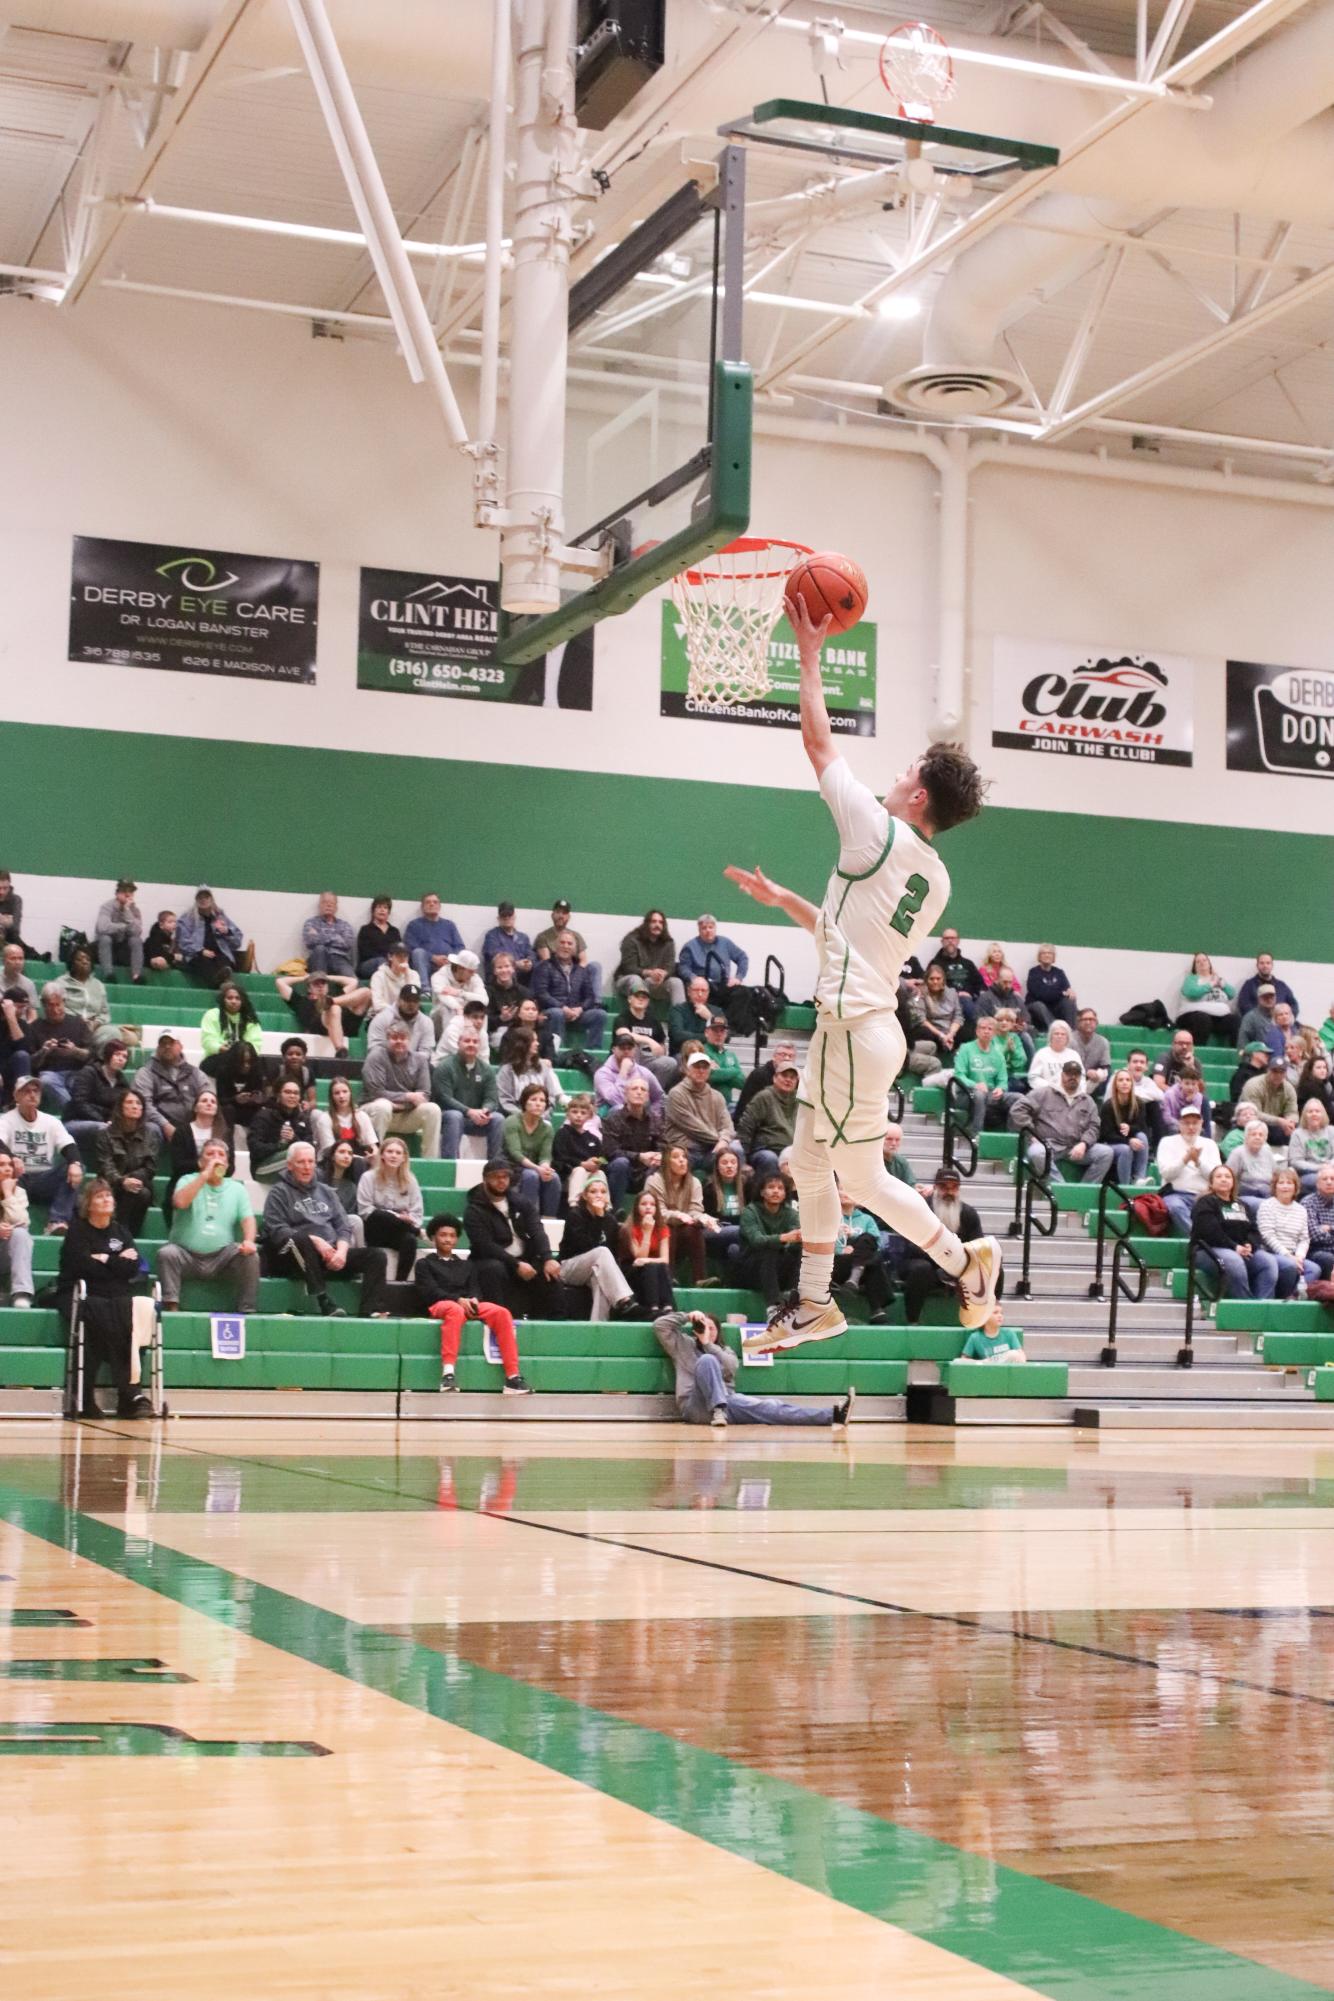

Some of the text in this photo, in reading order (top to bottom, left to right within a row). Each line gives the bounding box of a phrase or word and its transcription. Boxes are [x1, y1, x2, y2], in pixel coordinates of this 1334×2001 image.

[84, 586, 306, 624] DERBY EYE CARE
[370, 599, 450, 627] CLINT
[147, 617, 196, 631] LOGAN
[199, 622, 269, 639] BANISTER
[212, 658, 221, 668] E
[223, 660, 275, 673] MADISON
[278, 665, 302, 676] AVE
[389, 658, 505, 684] (316) 650-4323
[826, 648, 867, 668] BANK
[1022, 673, 1166, 728] Club
[1289, 677, 1334, 708] DERB
[1019, 719, 1164, 745] CARWASH
[1281, 713, 1334, 747] DON
[1032, 738, 1156, 761] JOIN THE CLUB!
[889, 873, 930, 938] 2
